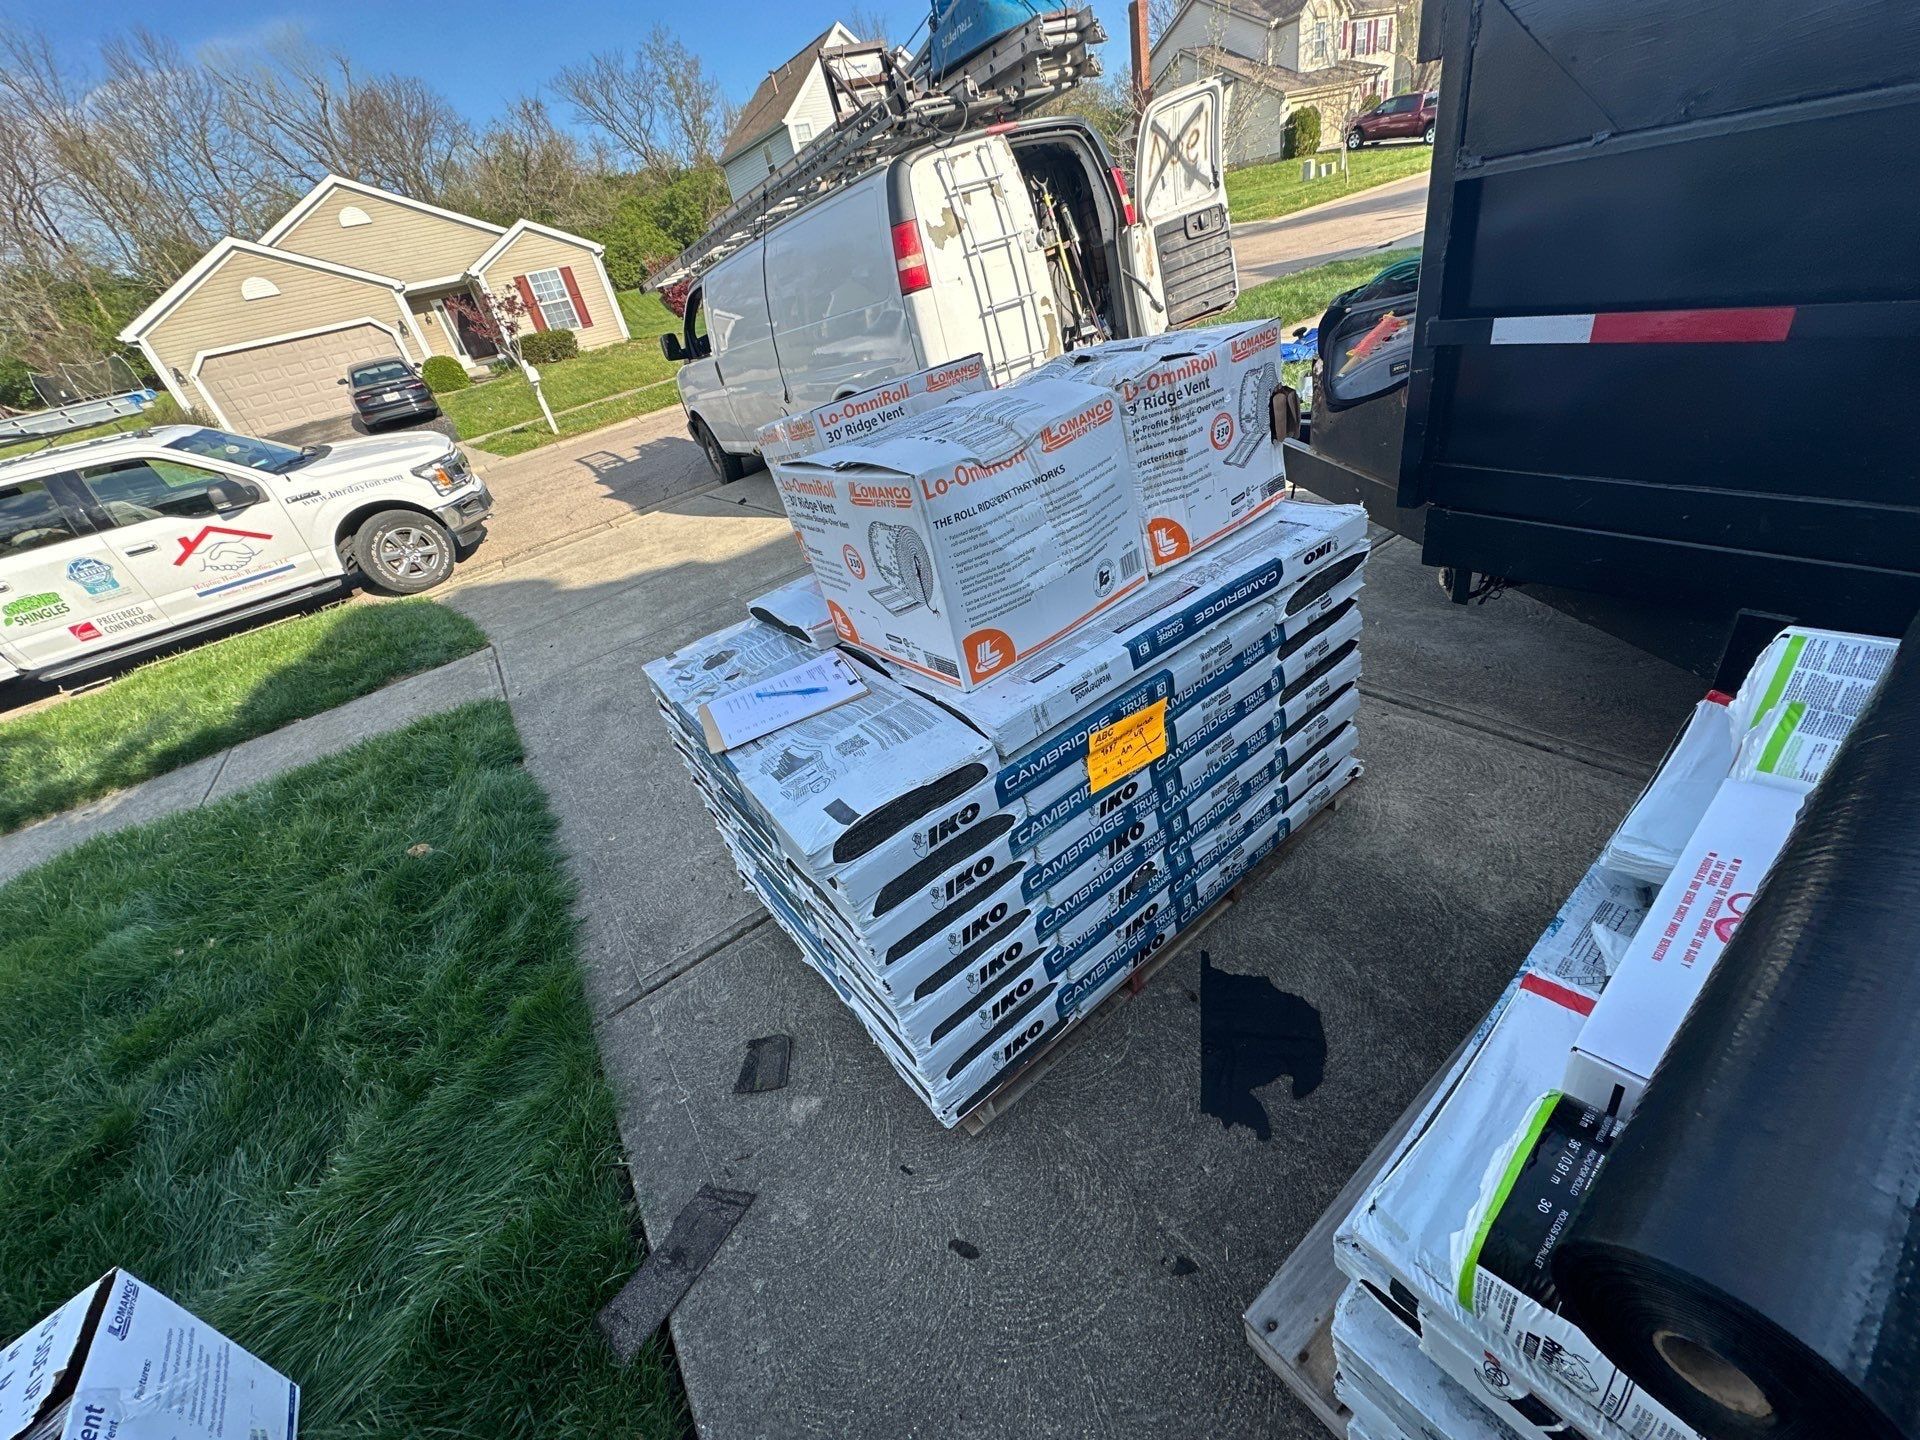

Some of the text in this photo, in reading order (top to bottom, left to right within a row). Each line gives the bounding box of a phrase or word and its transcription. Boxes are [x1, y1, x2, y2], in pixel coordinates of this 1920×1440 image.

[1231, 326, 1278, 354] LOMANCO
[1248, 343, 1267, 357] VENTS
[928, 362, 980, 386] LOMANCO
[948, 376, 970, 386] VENTS
[819, 382, 910, 428] Lo-OmniRoll
[1144, 376, 1211, 411] Ridge Vent
[845, 417, 878, 436] Ridge
[878, 406, 905, 422] Vent
[1040, 400, 1112, 444] LOMANCO
[1169, 405, 1211, 424] Shingle-Over
[1070, 420, 1098, 440] VENTS
[1168, 432, 1188, 444] Modelo
[1216, 425, 1229, 440] 330
[849, 482, 912, 499] LOMANCO
[933, 513, 953, 530] THE
[954, 503, 978, 522] ROLL
[1012, 482, 1034, 498] THAT
[1032, 464, 1066, 486] WORKS
[817, 500, 837, 516] Vent
[849, 557, 862, 570] 330
[1304, 540, 1332, 565] IKO
[2, 592, 64, 617] GREENER
[1194, 570, 1277, 624] CAMBRIDGE
[14, 602, 70, 626] SHINGLES
[96, 606, 144, 626] PREFERRED
[104, 613, 156, 634] CONTRACTOR
[1244, 649, 1266, 667] SQUARE
[1074, 672, 1112, 704] Weatherwood
[1164, 639, 1264, 712] AMBRIDGE TRUE
[1201, 685, 1229, 711] Weatherwood
[1004, 715, 1110, 790] CAMBRIDGE
[1120, 692, 1148, 716] TRUE
[1094, 727, 1114, 744] ABC
[1157, 706, 1237, 771] CAMBRIDGE
[1243, 686, 1266, 707] TRUE
[1205, 731, 1232, 757] Weatherwood
[1162, 749, 1239, 814] CAMBRIDGE
[1246, 728, 1267, 748] TRUE
[1211, 772, 1238, 799] Weatherwood
[1018, 783, 1091, 844] CAMBRI
[1100, 782, 1138, 818] IKO
[1136, 801, 1160, 821] SQUARE
[1169, 788, 1242, 855] CAMBRIDGE
[1249, 768, 1270, 788] TRUE
[928, 802, 980, 849] IKO
[1029, 791, 1159, 890] CAMBRIDGE TRUE
[1109, 822, 1145, 860] IKO
[1144, 840, 1167, 859] SQUARE
[1174, 827, 1245, 892] CAMBRIDGE
[1252, 804, 1271, 824] TRUE
[945, 856, 995, 901] IKO
[1042, 828, 1167, 929] CAMBRIDGE TRUE
[1181, 838, 1274, 924] CAMBRIDGE TRUE
[962, 902, 1008, 947] IKO
[1126, 903, 1158, 937] IKO
[1062, 906, 1177, 1005] CAMBRIDGE TRUE
[1133, 933, 1165, 968] IKO
[1683, 949, 1698, 963] OJOS
[1690, 939, 1703, 949] LOS
[979, 941, 1023, 985] IKO
[992, 978, 1034, 1020] IKO
[1004, 1020, 1044, 1062] IKO
[1555, 1157, 1572, 1176] 0.91
[1578, 1165, 1590, 1178] POR
[1583, 1149, 1598, 1166] ANCHO
[1570, 1177, 1584, 1196] ROLLO
[1538, 1198, 1553, 1214] 30
[1534, 1209, 1569, 1269] ROLLOS POR PALLET
[108, 1280, 136, 1334] LOMANCO
[126, 1296, 138, 1320] VENTS
[24, 1372, 44, 1401] UP
[134, 1356, 152, 1401] Features:
[79, 1404, 106, 1440] ent
